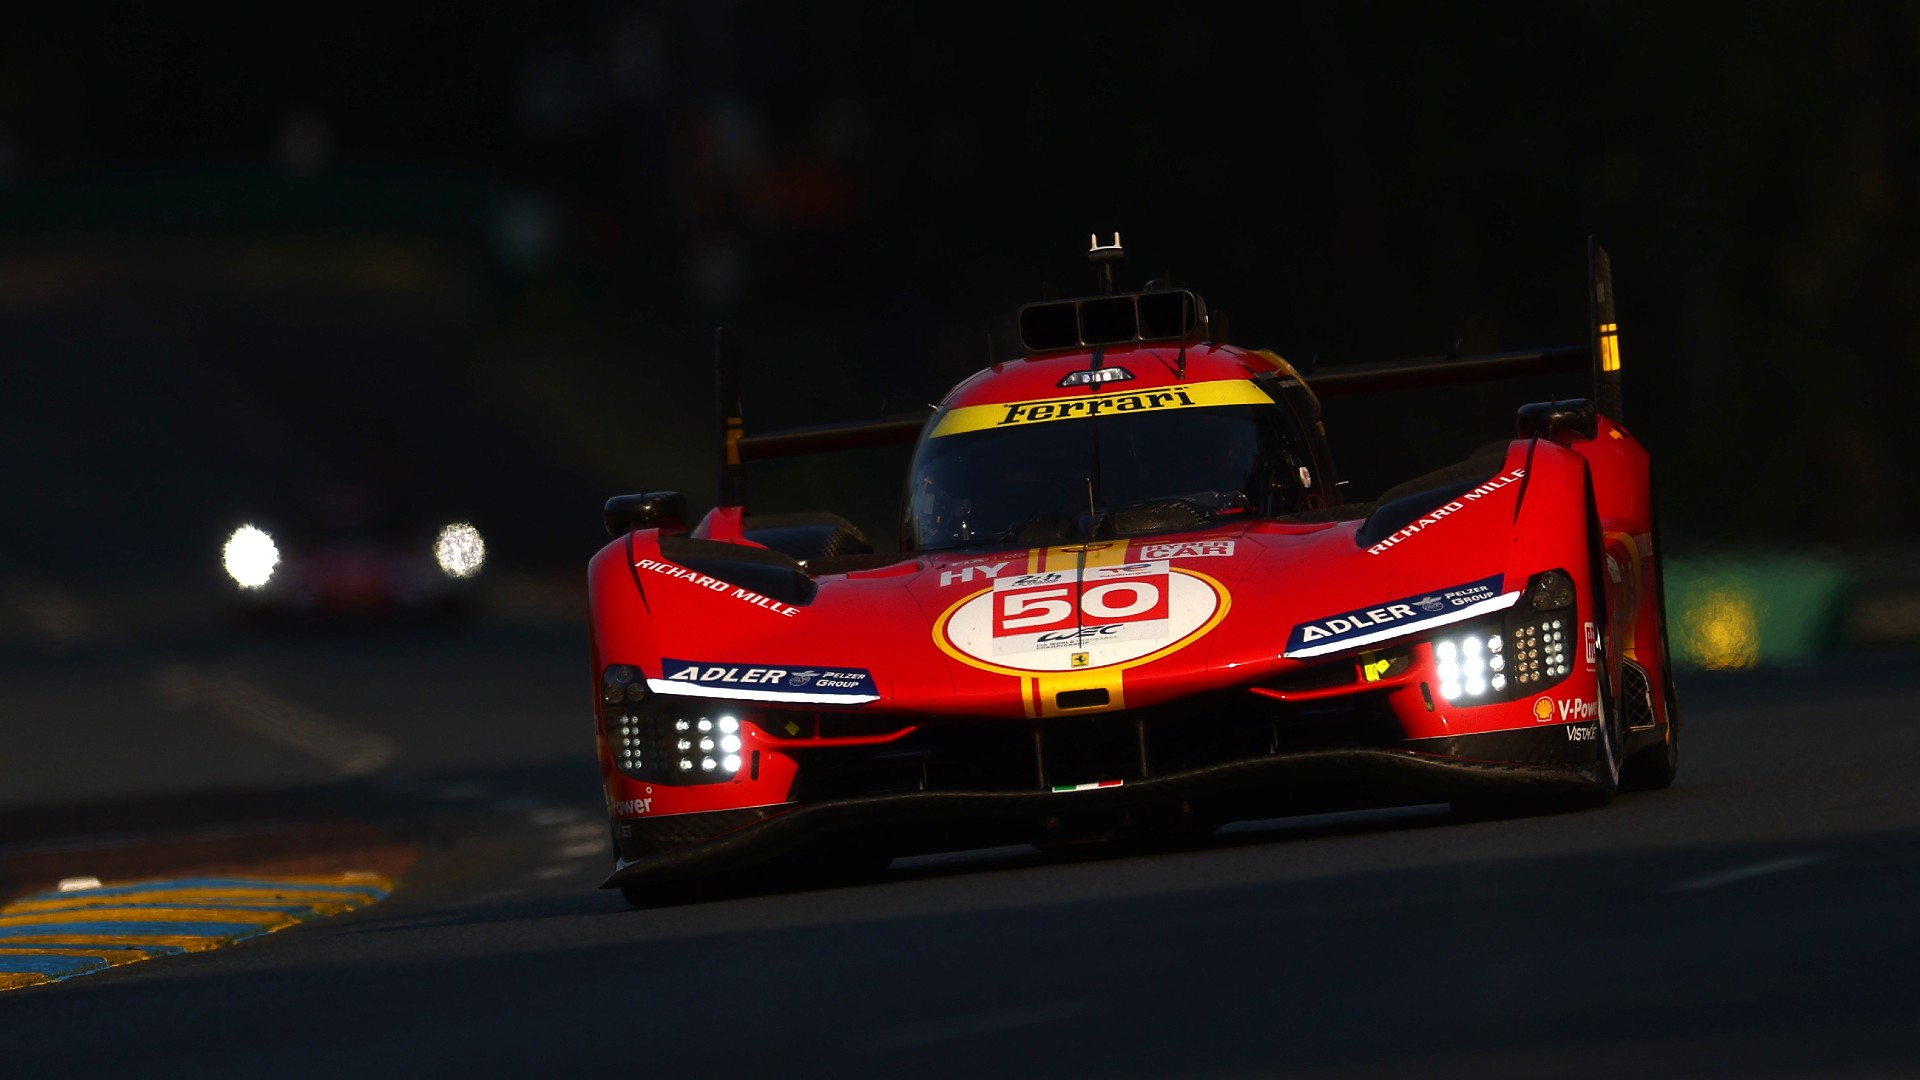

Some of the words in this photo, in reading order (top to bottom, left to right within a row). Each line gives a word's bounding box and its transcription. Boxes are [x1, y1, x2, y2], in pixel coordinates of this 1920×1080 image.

[998, 387, 1196, 425] Ferrari
[1367, 501, 1463, 556] RICHARD
[1464, 467, 1526, 502] MILLE
[1145, 547, 1228, 558] CAR
[940, 561, 1010, 587] HY
[635, 558, 730, 593] RICHARD
[730, 587, 801, 618] MILLE
[1444, 585, 1488, 600] PELZER
[1002, 581, 1159, 630] 50
[1451, 591, 1495, 607] GROUP
[1037, 623, 1124, 643] WEC
[1302, 603, 1417, 643] ADLER
[668, 666, 787, 684] ADLER
[815, 679, 859, 689] GROUP
[822, 671, 866, 680] PELZER
[1557, 698, 1598, 721] V-Powe
[616, 797, 653, 816] ower
